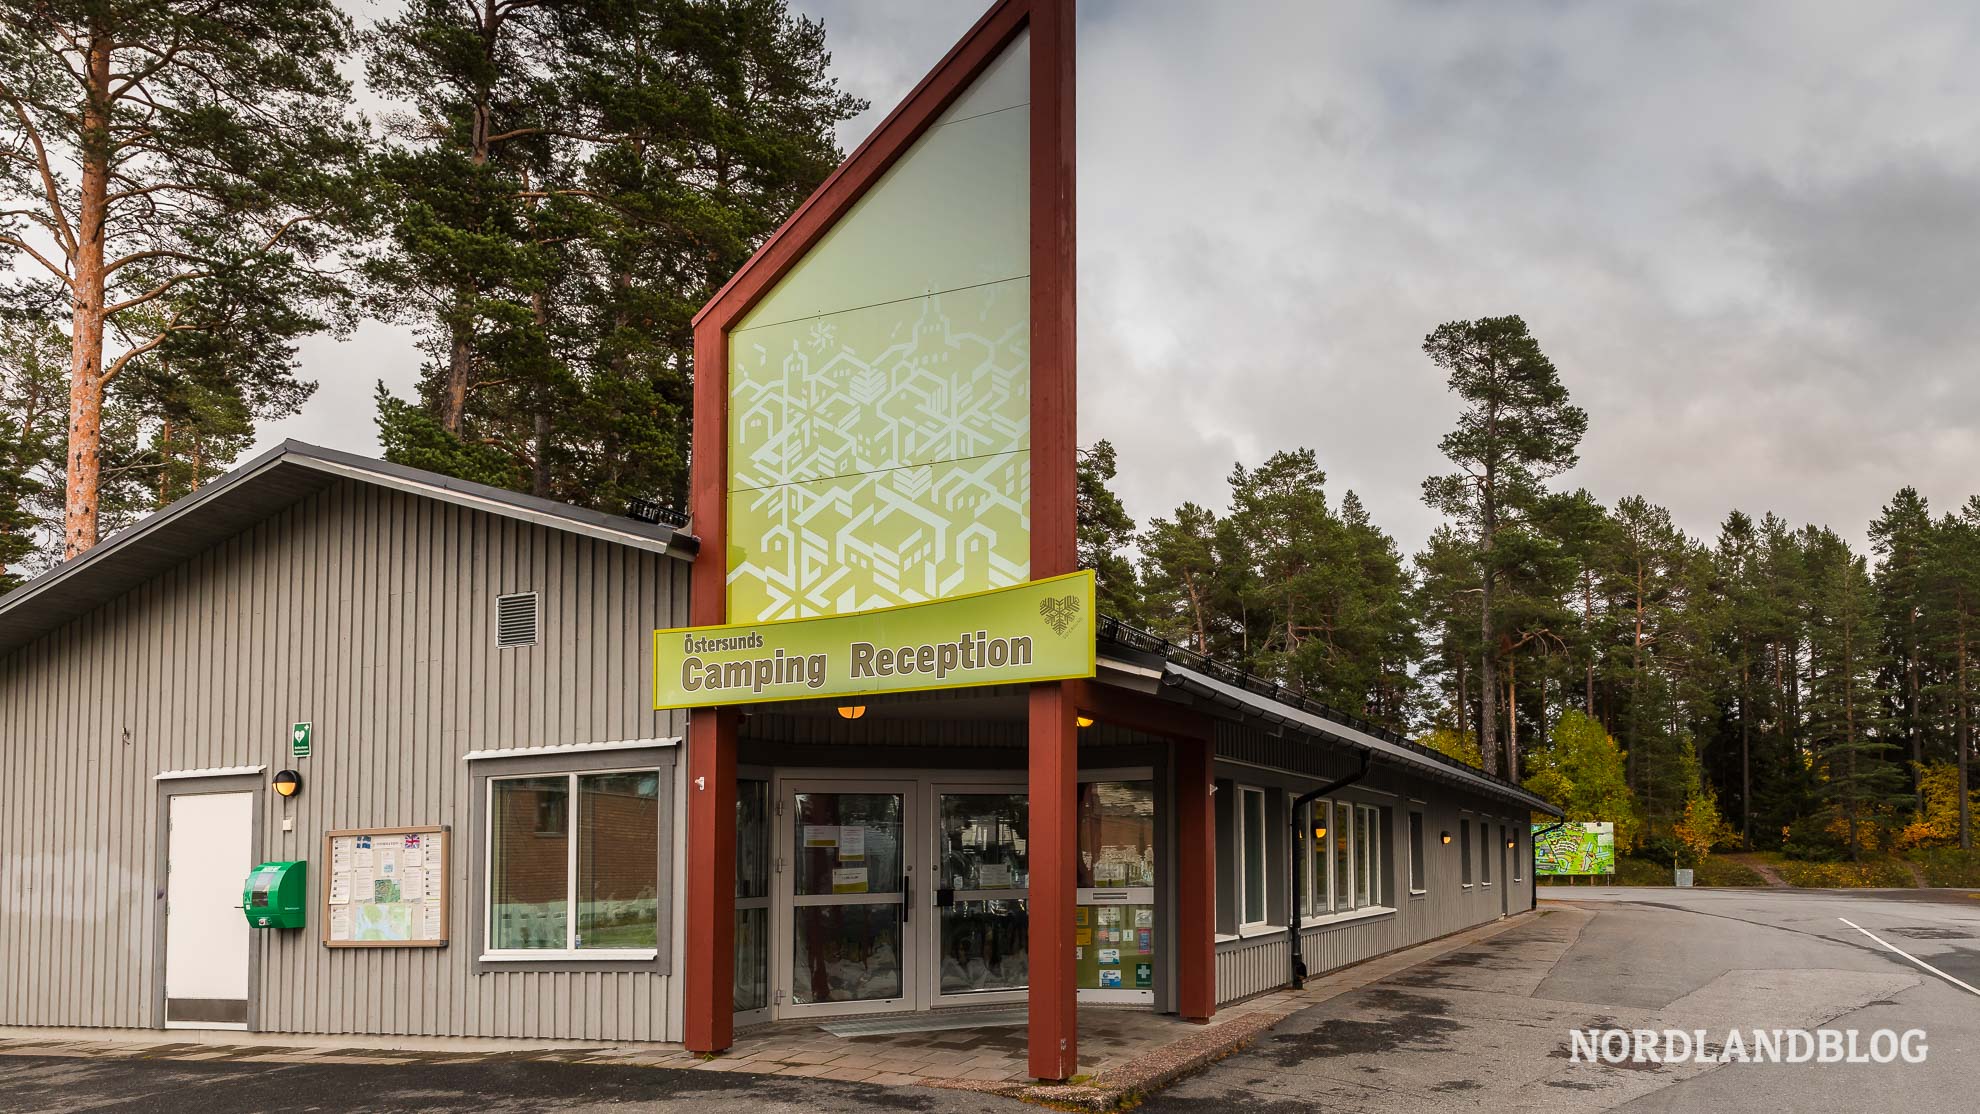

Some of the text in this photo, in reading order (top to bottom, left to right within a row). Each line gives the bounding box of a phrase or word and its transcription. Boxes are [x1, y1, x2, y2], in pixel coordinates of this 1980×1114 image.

[682, 630, 1033, 693] Camping Reception
[684, 632, 764, 654] Östersunds
